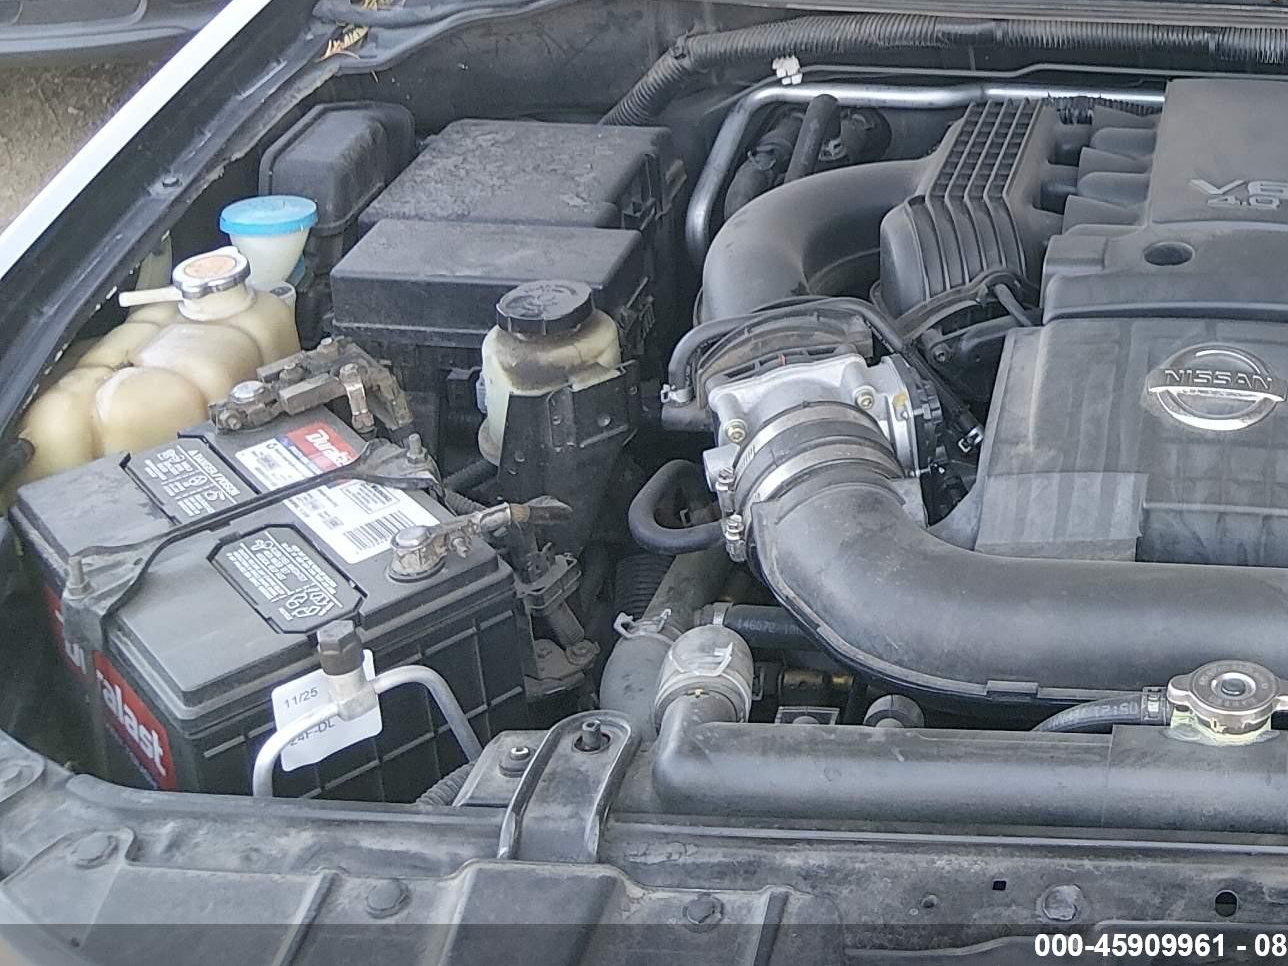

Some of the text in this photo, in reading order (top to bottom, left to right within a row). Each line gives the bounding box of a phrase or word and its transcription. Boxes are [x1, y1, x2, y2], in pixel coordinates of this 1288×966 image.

[1207, 194, 1281, 211] 4.0
[1164, 369, 1273, 390] NISSAN
[284, 687, 319, 709] 11/25
